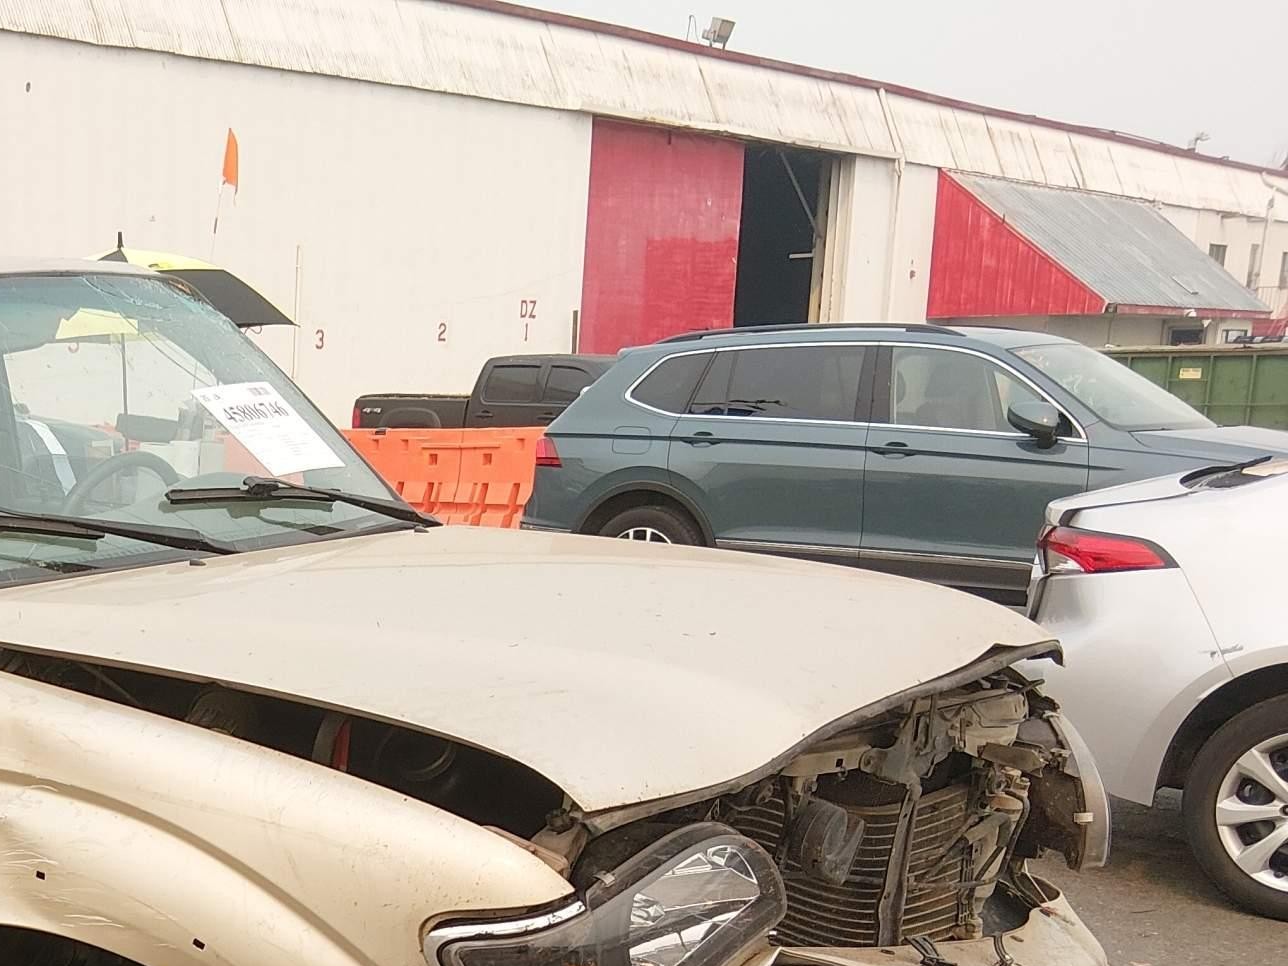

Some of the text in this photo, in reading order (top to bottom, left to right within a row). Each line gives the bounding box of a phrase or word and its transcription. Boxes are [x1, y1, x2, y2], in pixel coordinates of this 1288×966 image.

[520, 300, 537, 319] DZ
[315, 329, 325, 350] 3
[437, 323, 447, 342] 2
[222, 400, 290, 424] 45806746
